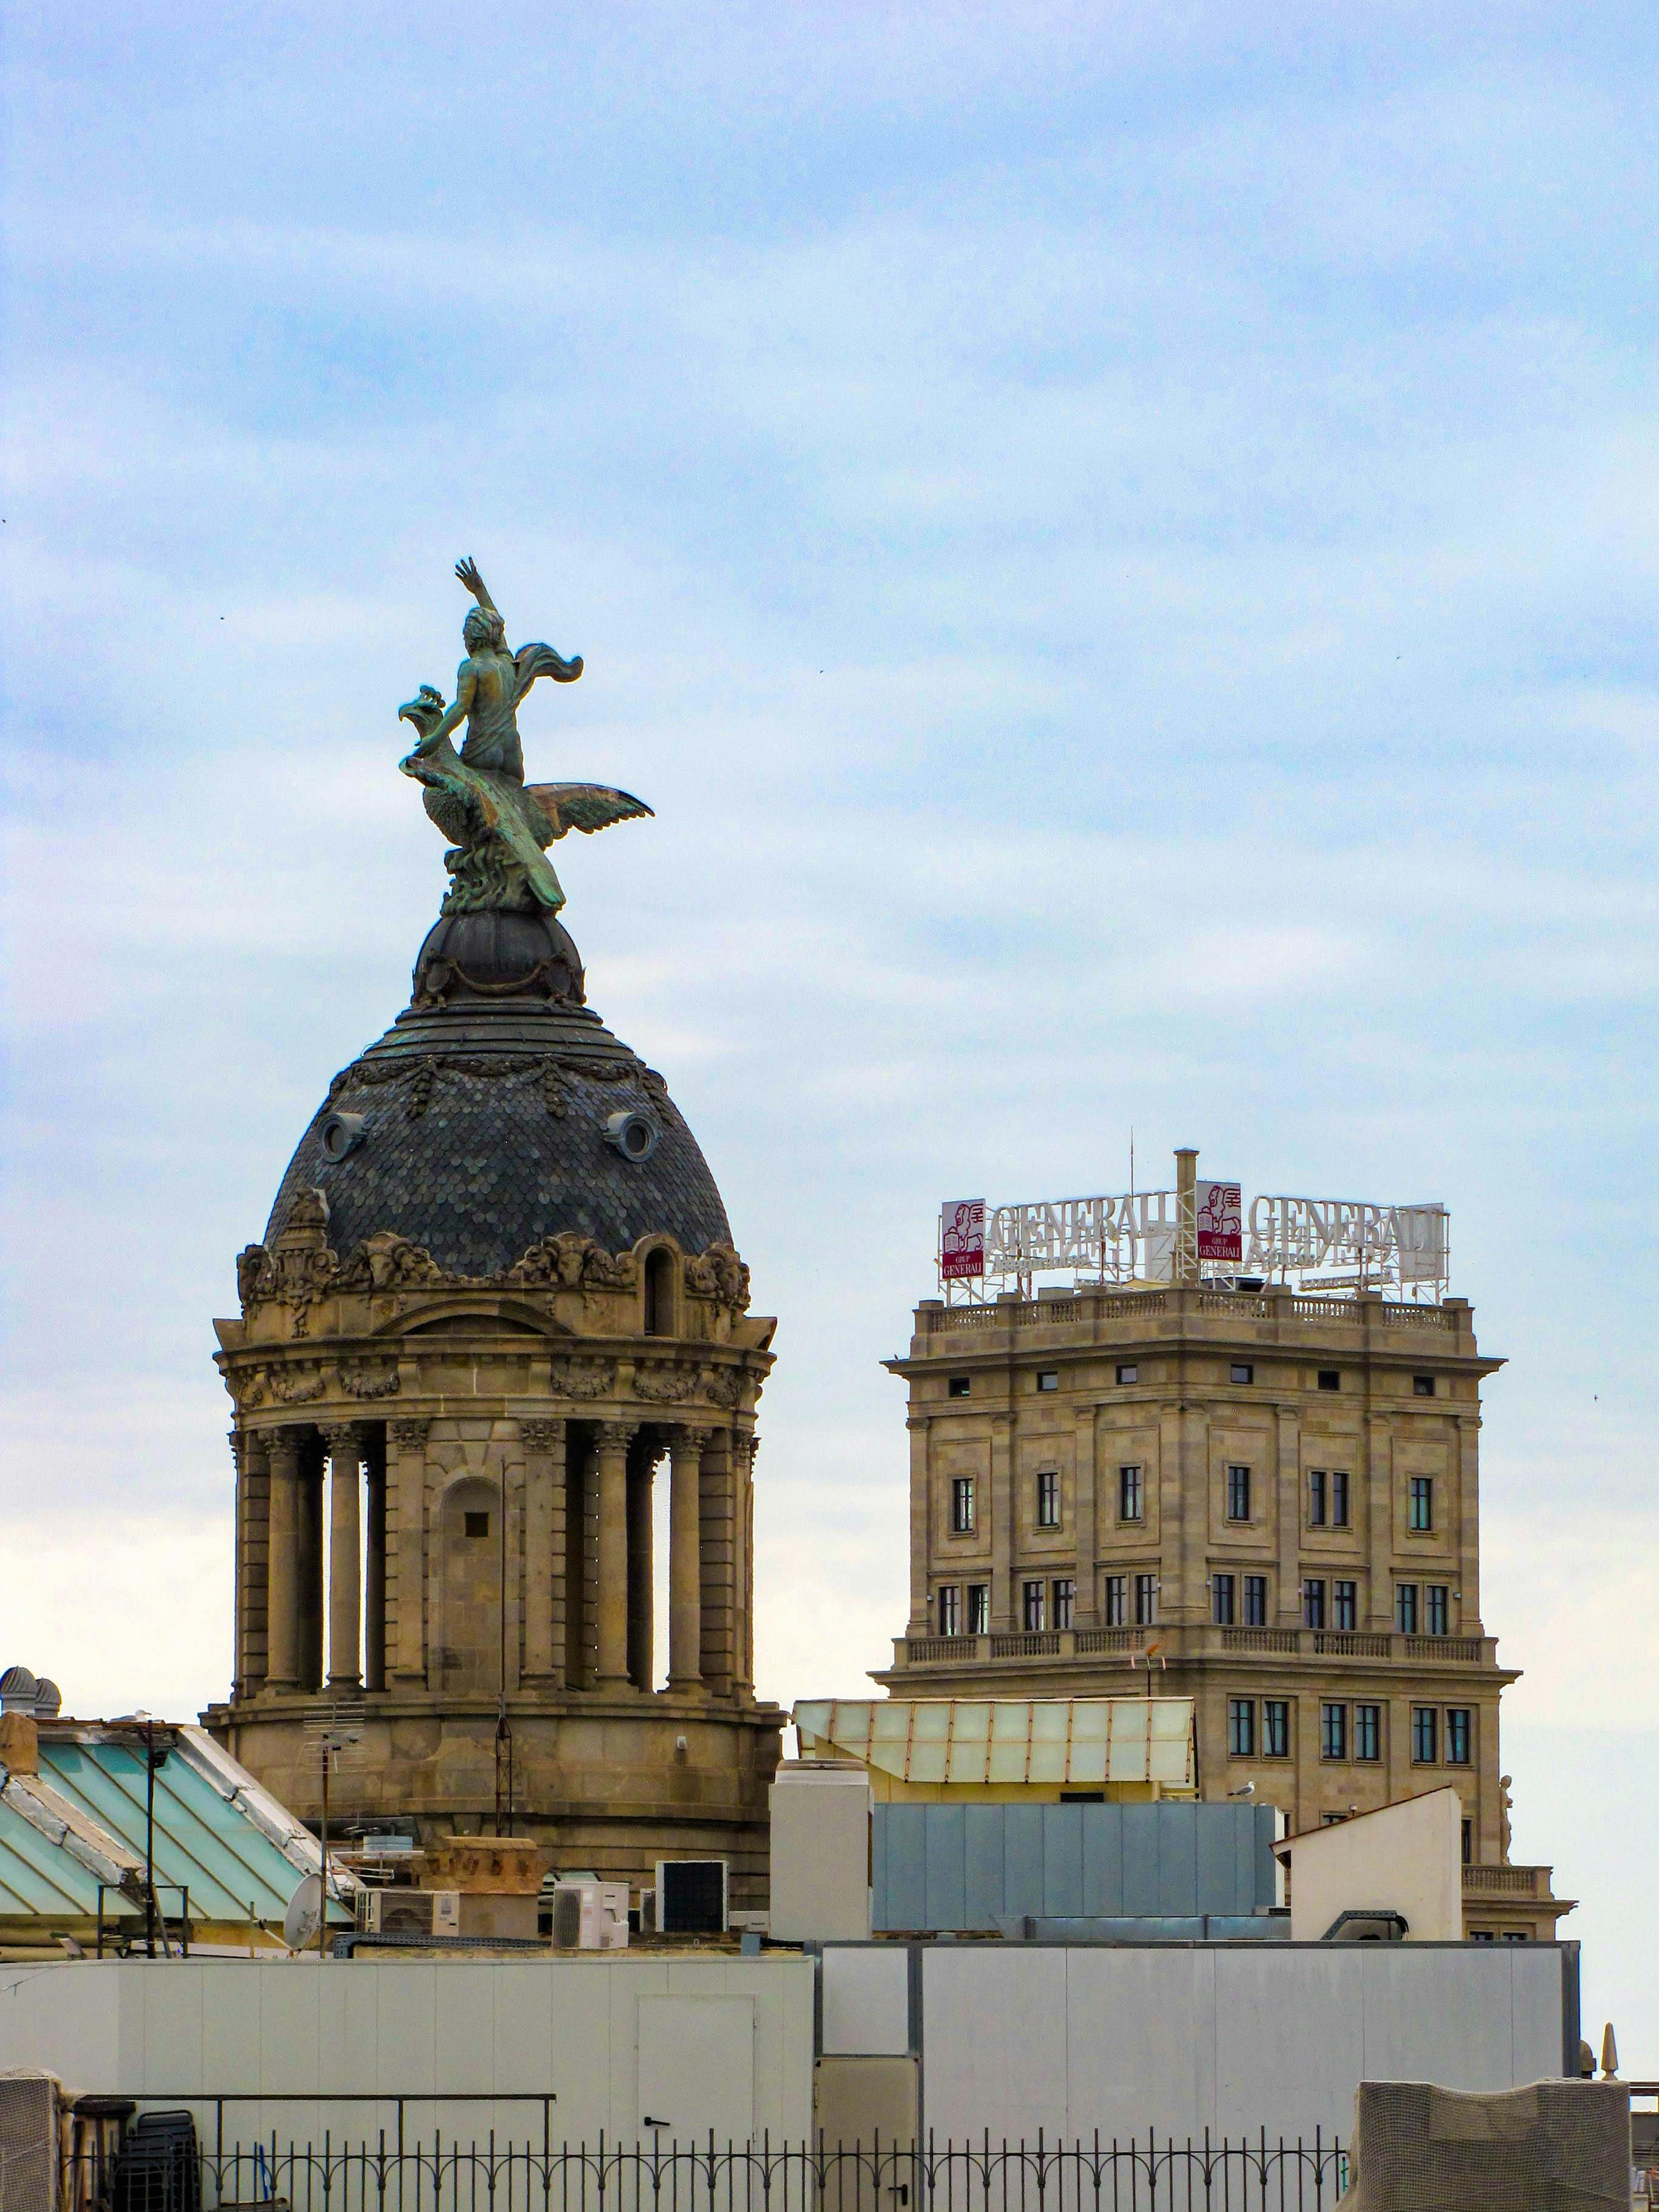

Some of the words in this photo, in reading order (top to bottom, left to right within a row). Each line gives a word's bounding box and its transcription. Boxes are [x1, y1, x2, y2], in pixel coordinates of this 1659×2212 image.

[992, 1191, 1170, 1249] GENERALI
[1200, 1245, 1240, 1258] GENERALI
[944, 1262, 982, 1276] GENERALI
